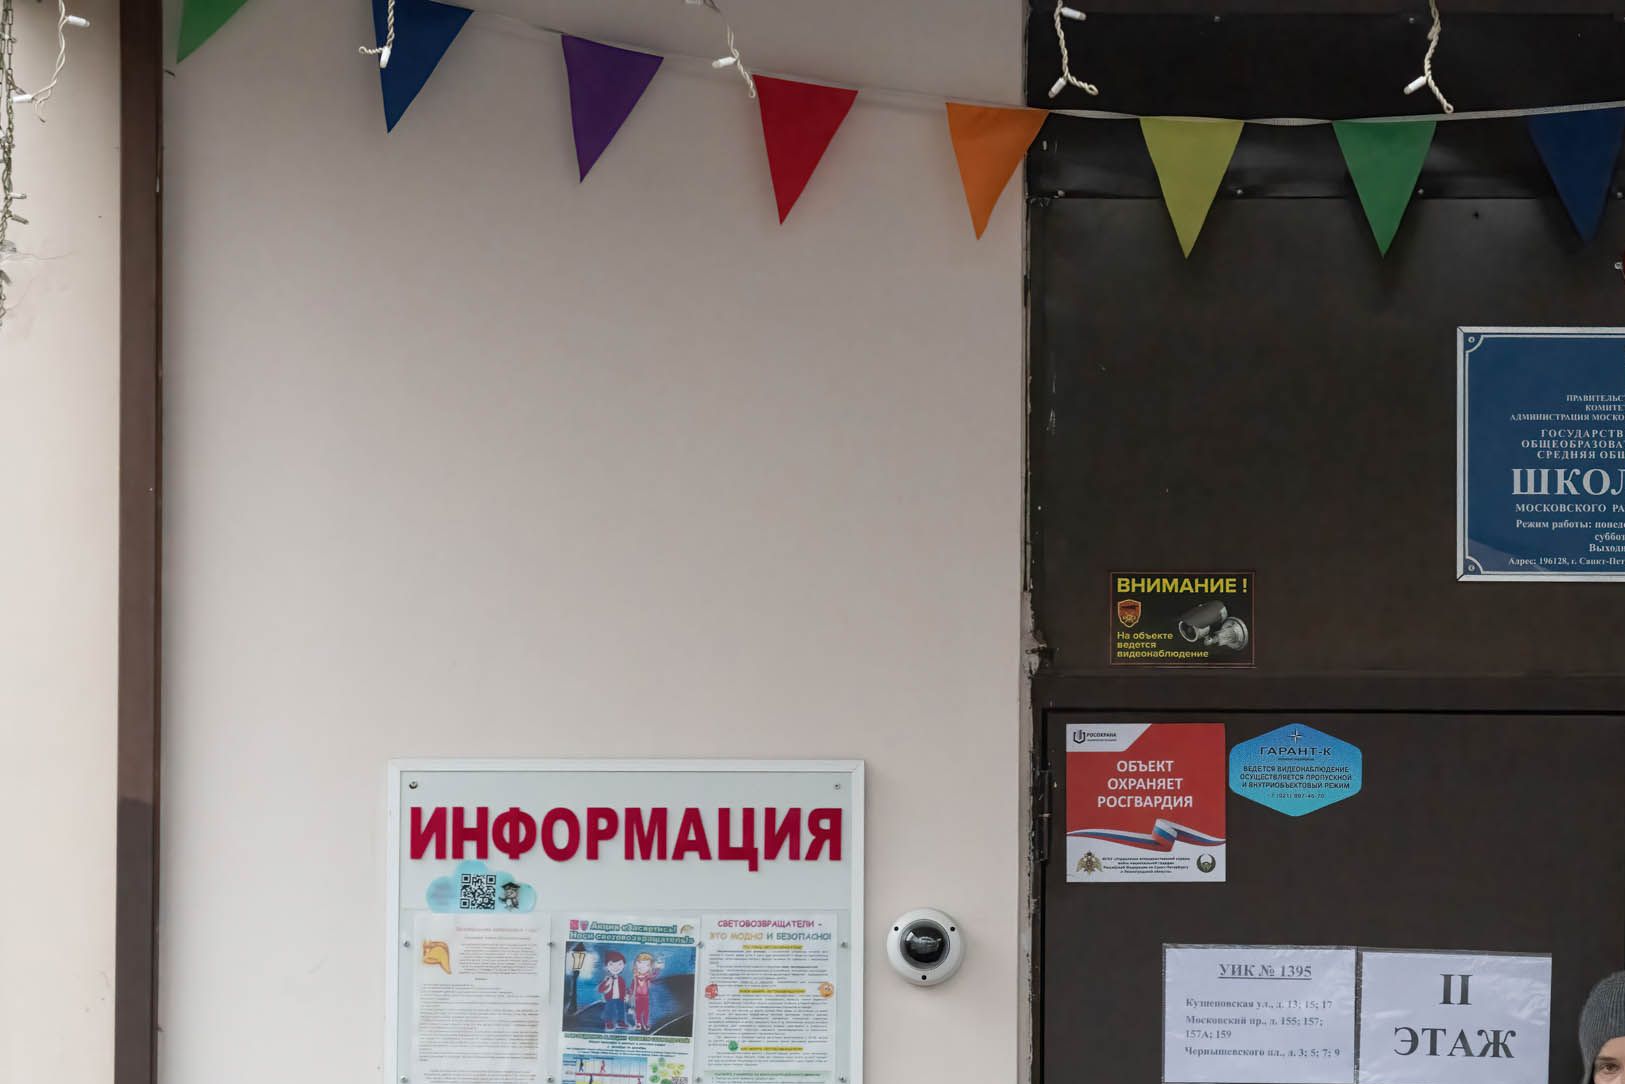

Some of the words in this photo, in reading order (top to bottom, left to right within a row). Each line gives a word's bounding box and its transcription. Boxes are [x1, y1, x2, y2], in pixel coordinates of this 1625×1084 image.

[1510, 413, 1590, 422] АДМИНИСТРАЦИЯ
[1536, 450, 1596, 460] СРЕДНЯЯ
[1515, 503, 1607, 513] МОСКОВСКОГО
[1516, 519, 1549, 529] Режим
[1551, 519, 1592, 531] работы:
[1509, 557, 1537, 566] Адрес:
[1539, 557, 1569, 566] 196128,
[1117, 577, 1237, 593] ВНИМАНИЕ
[1117, 631, 1130, 640] На
[1132, 631, 1174, 640] объекте
[1117, 641, 1157, 649] ведется
[1117, 650, 1209, 659] видеонаблюдение
[1260, 747, 1332, 756] ГАРАНТ-К
[1116, 760, 1174, 773] ОБЪЕКТ
[1243, 765, 1276, 773] ВЕДЕТСЯ
[1107, 777, 1184, 790] ОХРАНЯЕТ
[1248, 781, 1322, 789] ВНУТРИОБЪЕКТОВЫЙ
[1097, 795, 1193, 810] РОСГВАРДИЯ
[408, 806, 843, 873] ИНФОРМАЦИЯ
[590, 920, 620, 931] Акция
[717, 919, 815, 929] СВЕТОВОЗВРАЩАТЕЛИ
[569, 931, 594, 940] Носи
[766, 933, 774, 941] И
[776, 932, 832, 941] БЕЗОПАСНО!
[1217, 963, 1256, 977] УИК
[1258, 965, 1276, 977] №
[1280, 965, 1312, 978] 1395
[1439, 972, 1473, 1005] II
[1304, 999, 1319, 1010] 15;
[1322, 1000, 1333, 1009] 17
[1185, 1015, 1247, 1025] Московский
[1281, 1017, 1301, 1026] 155;
[1303, 1017, 1324, 1027] 157;
[1216, 1030, 1232, 1039] 159
[1392, 1026, 1517, 1059] ЭТАЖ
[1184, 1046, 1265, 1058] Чернышевского
[1310, 1048, 1320, 1058] 5;
[1322, 1048, 1332, 1058] 7;
[1334, 1049, 1340, 1057] 9
